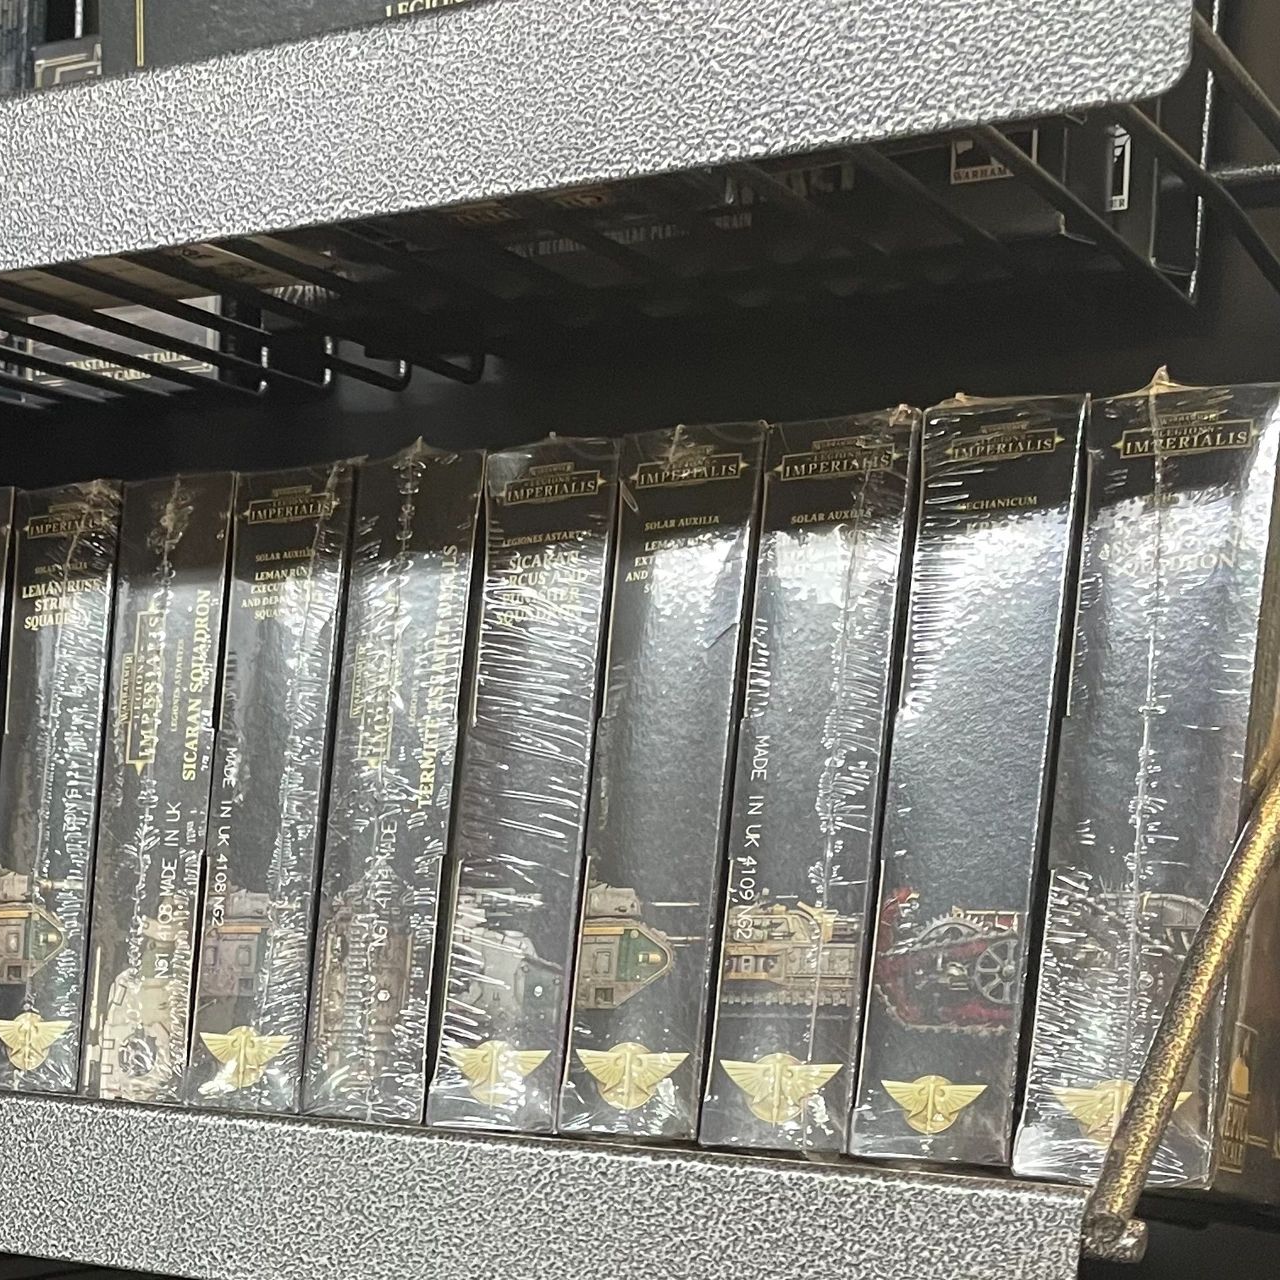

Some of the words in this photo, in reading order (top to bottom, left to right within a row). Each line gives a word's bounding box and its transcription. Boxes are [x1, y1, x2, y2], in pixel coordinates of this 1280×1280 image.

[954, 438, 1052, 459] IMPERIALIS
[1126, 432, 1248, 454] IMPERIALIS
[640, 464, 737, 485] IMPERIALIS
[784, 454, 890, 478] IMPERIALIS
[507, 481, 596, 502] IMPERIALIS
[251, 504, 331, 520] IMPERIALIS
[791, 513, 825, 525] SOLAR
[644, 519, 676, 532] SOLAR
[678, 515, 720, 528] AUXILIA
[255, 552, 281, 562] SOLAR
[255, 569, 287, 581] LEMAN
[22, 582, 62, 599] LEMAN
[241, 598, 260, 608] AND
[189, 588, 212, 693] SQUADRON
[138, 615, 161, 756] IMPERIALIS
[182, 698, 201, 781] SICARAN
[222, 747, 238, 789] MADE
[418, 718, 439, 807] TERMITE
[750, 735, 771, 782] MADE
[166, 801, 181, 822] UK
[219, 800, 232, 818] IN
[746, 795, 764, 816] IN
[164, 829, 179, 847] IN
[217, 825, 231, 847] UK
[743, 824, 761, 848] UK
[159, 859, 178, 896] MADE
[214, 853, 228, 892] 4108
[739, 856, 758, 901] 4109
[212, 896, 226, 927] NG2
[735, 905, 754, 939] NG2
